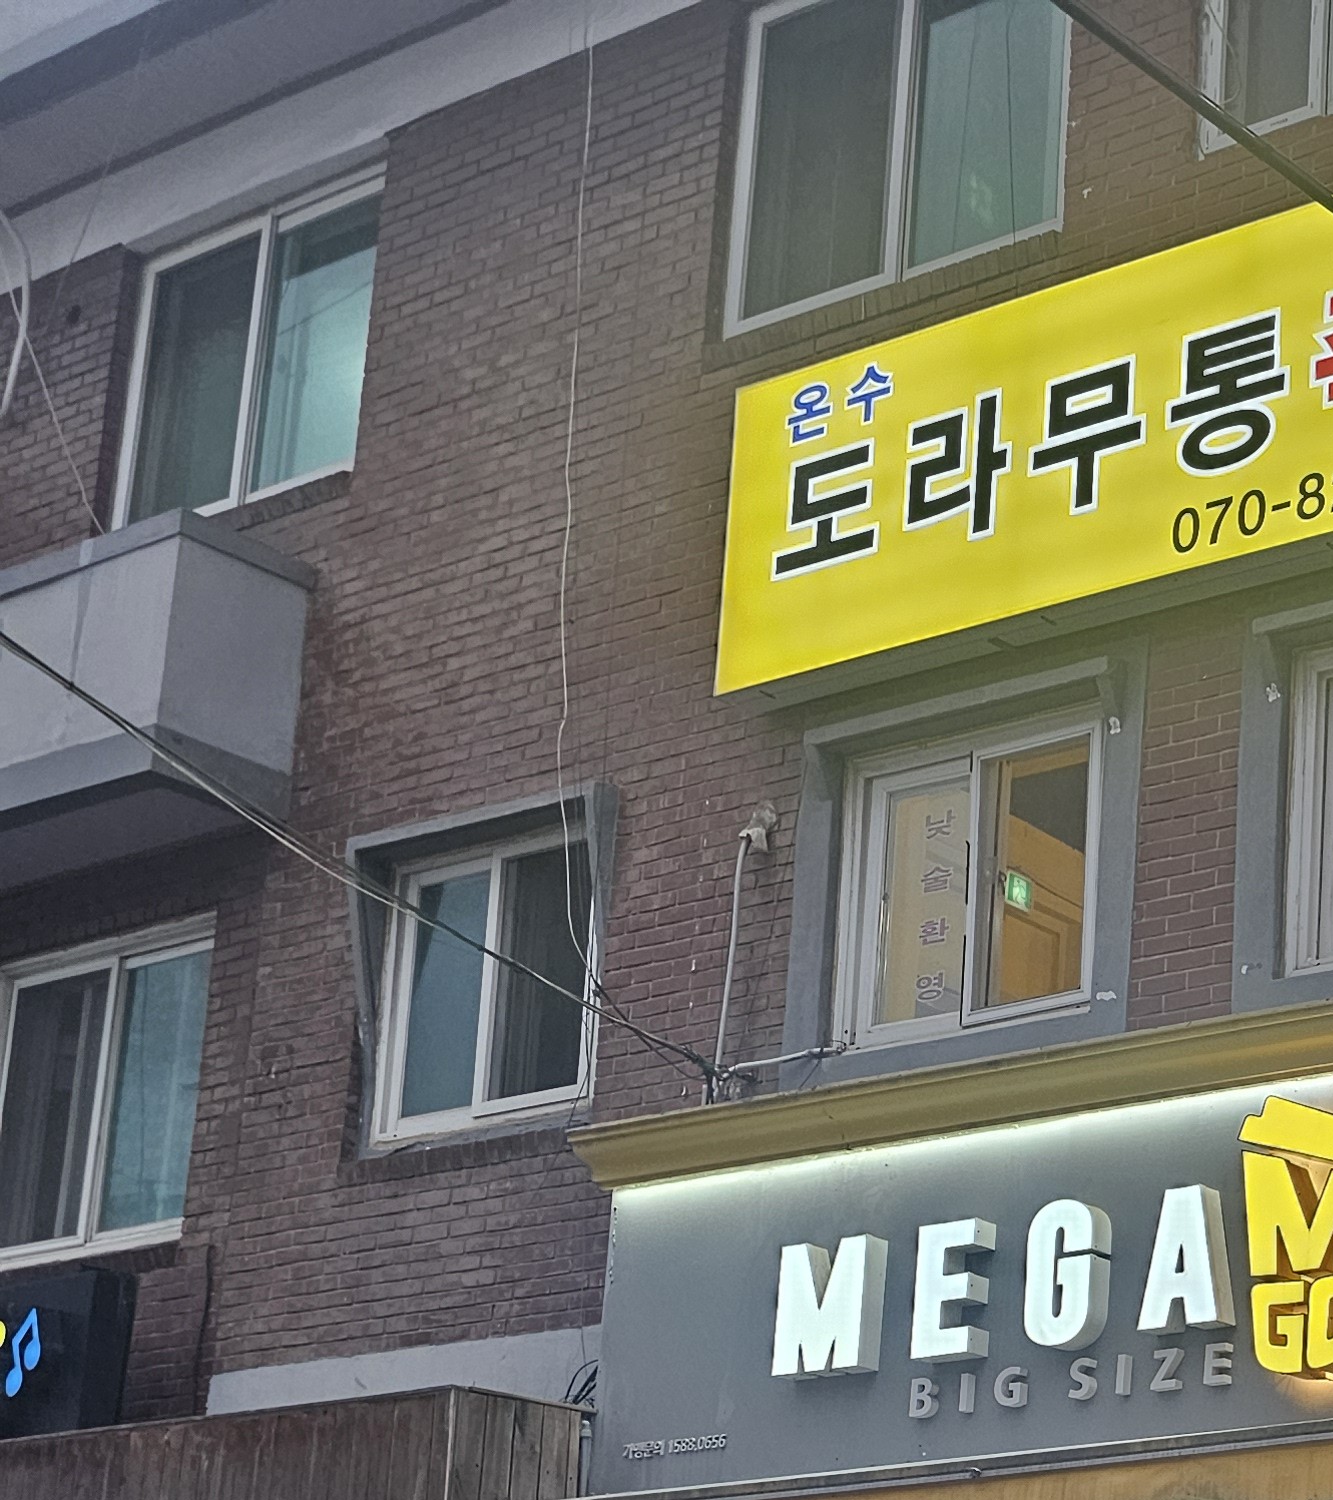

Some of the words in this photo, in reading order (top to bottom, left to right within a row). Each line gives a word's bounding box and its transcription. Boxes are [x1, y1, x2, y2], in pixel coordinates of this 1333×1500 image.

[786, 362, 895, 445] 온수
[771, 1183, 1236, 1381] MEGA
[909, 1365, 1029, 1419] BIG
[1067, 1342, 1235, 1402] SIZE
